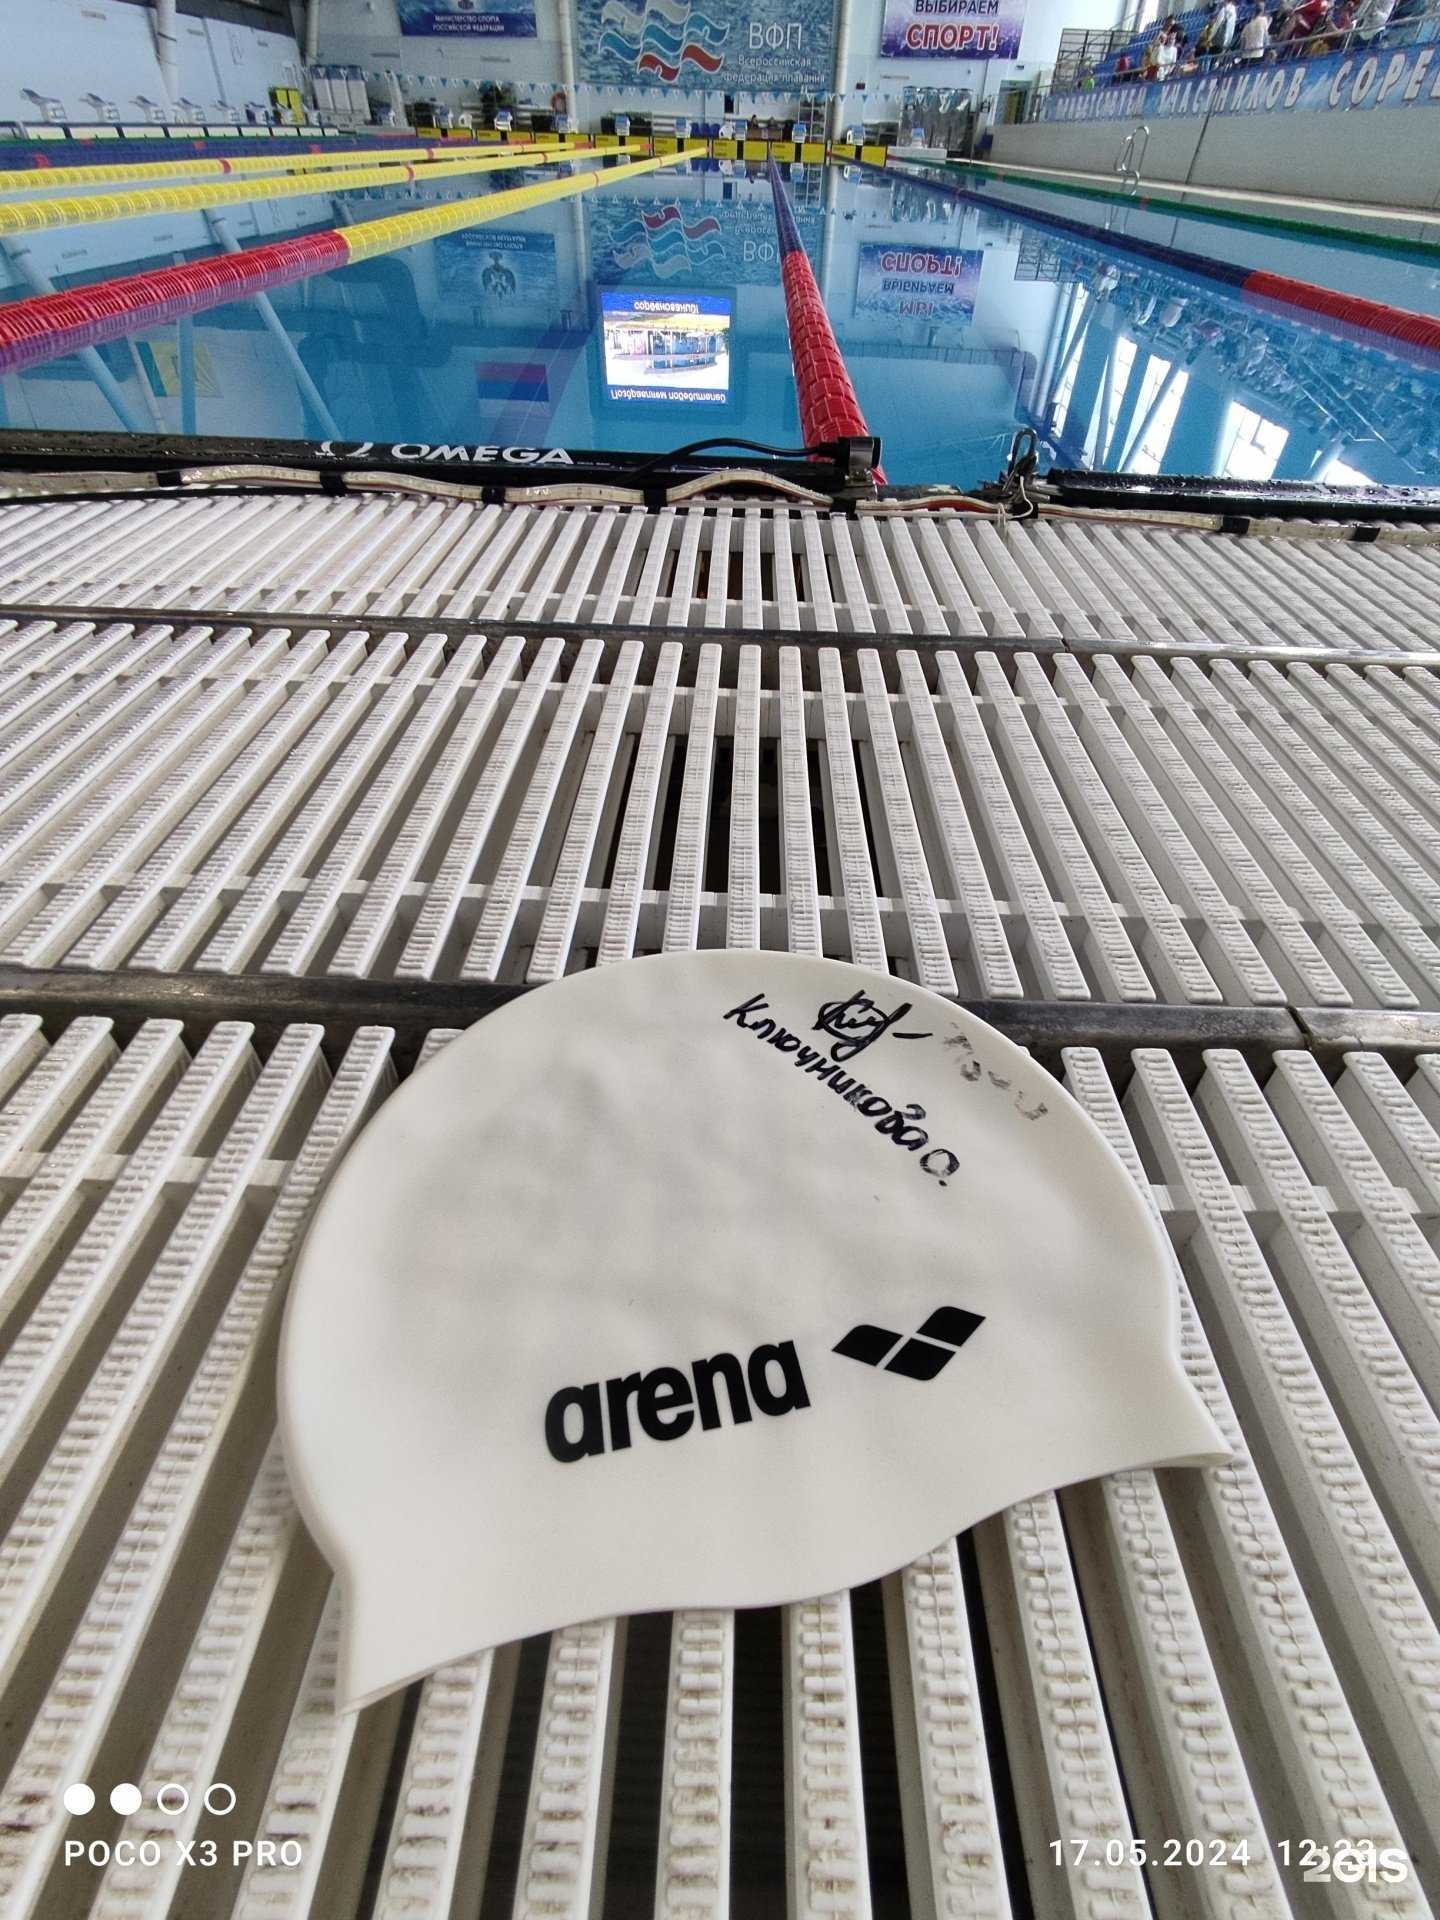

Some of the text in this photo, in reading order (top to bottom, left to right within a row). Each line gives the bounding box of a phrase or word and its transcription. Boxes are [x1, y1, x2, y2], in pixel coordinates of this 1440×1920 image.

[915, 0, 999, 14] ВЫБИРАЕМ
[749, 22, 802, 50] ВФП
[906, 22, 1000, 50] СПОРТ!
[738, 55, 811, 66] Всероссийская
[1328, 49, 1440, 108] СОРЕ
[390, 442, 574, 465] OMEGA
[544, 1340, 811, 1463] arena
